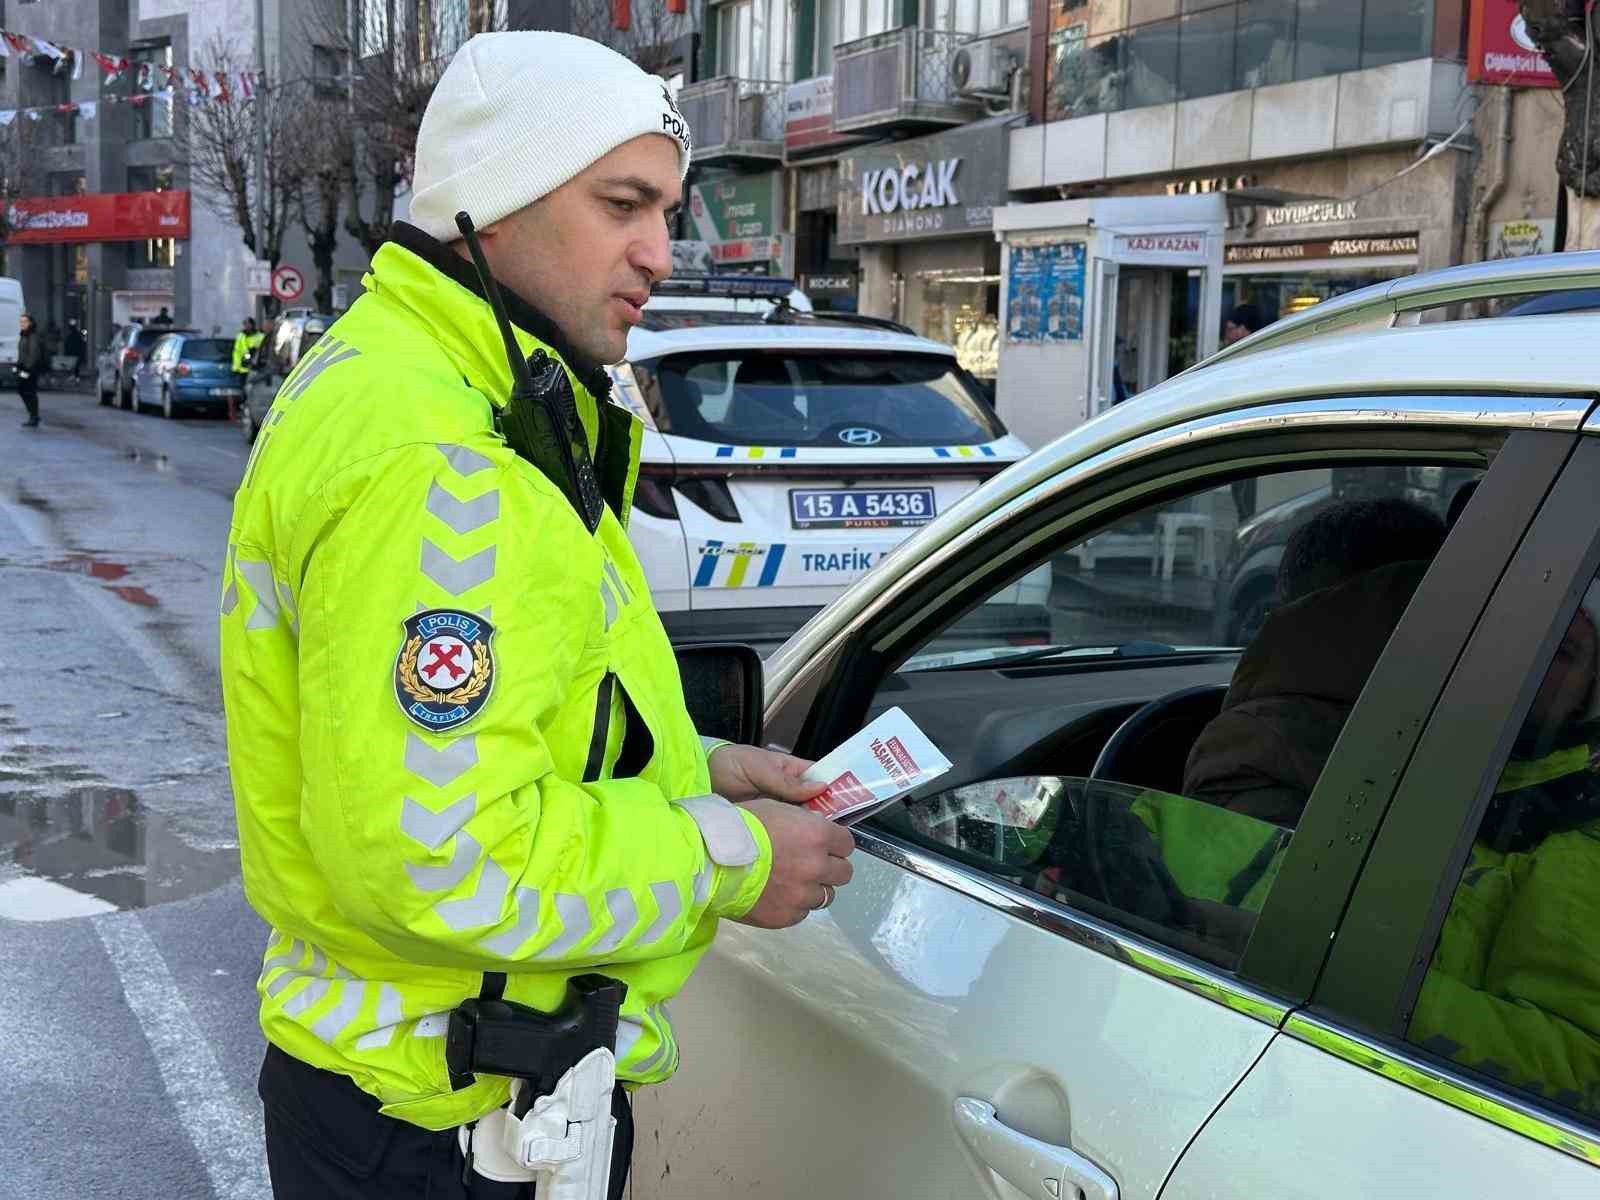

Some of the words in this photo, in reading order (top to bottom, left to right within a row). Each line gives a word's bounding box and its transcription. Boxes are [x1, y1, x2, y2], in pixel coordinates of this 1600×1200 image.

[883, 213, 943, 233] DIAMOND
[1265, 202, 1357, 226] KUYUMCULUK
[1127, 238, 1155, 251] KAZI
[1157, 237, 1199, 252] KAZAN
[1330, 240, 1369, 255] ATASAY
[1371, 238, 1417, 252] PIRLANTA
[803, 495, 833, 517] 15
[841, 495, 859, 516] A
[865, 494, 925, 515] 5436
[801, 548, 872, 571] TRAFİK
[429, 616, 470, 629] POLİS
